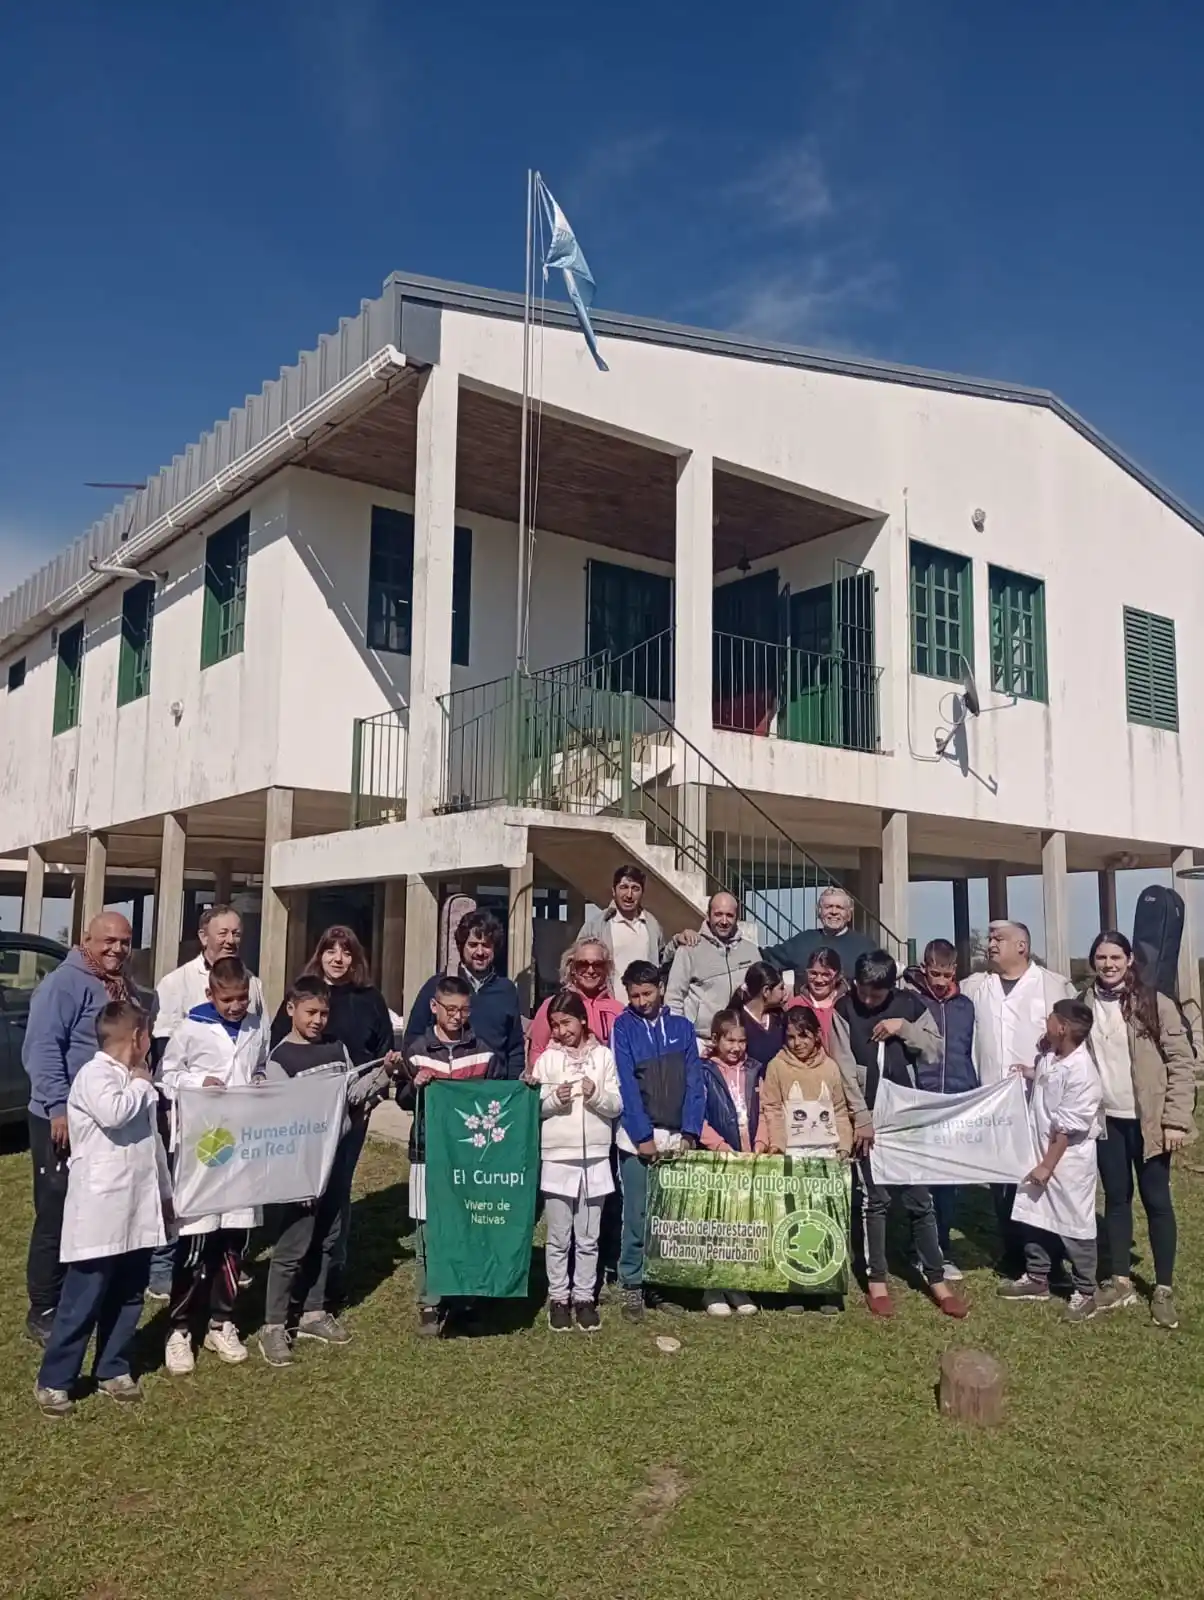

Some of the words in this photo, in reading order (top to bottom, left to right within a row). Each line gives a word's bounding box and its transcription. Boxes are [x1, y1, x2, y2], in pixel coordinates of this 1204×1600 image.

[241, 1119, 328, 1142] Humedales
[955, 1130, 983, 1145] Red
[241, 1147, 260, 1159] en
[266, 1139, 296, 1156] Red
[453, 1168, 466, 1185] El
[473, 1167, 526, 1187] Curupí
[660, 1165, 733, 1195] Gualeguay
[737, 1171, 751, 1191] te
[754, 1171, 799, 1197] quiero
[804, 1172, 843, 1196] verde
[464, 1199, 494, 1211] Vivero
[497, 1197, 511, 1211] de
[471, 1213, 506, 1225] Nativas
[651, 1216, 695, 1237] Proyecto
[696, 1218, 709, 1235] de
[710, 1219, 769, 1239] Forestación
[660, 1240, 697, 1259] Urbano
[697, 1246, 705, 1263] y
[706, 1243, 760, 1262] Periurbano
